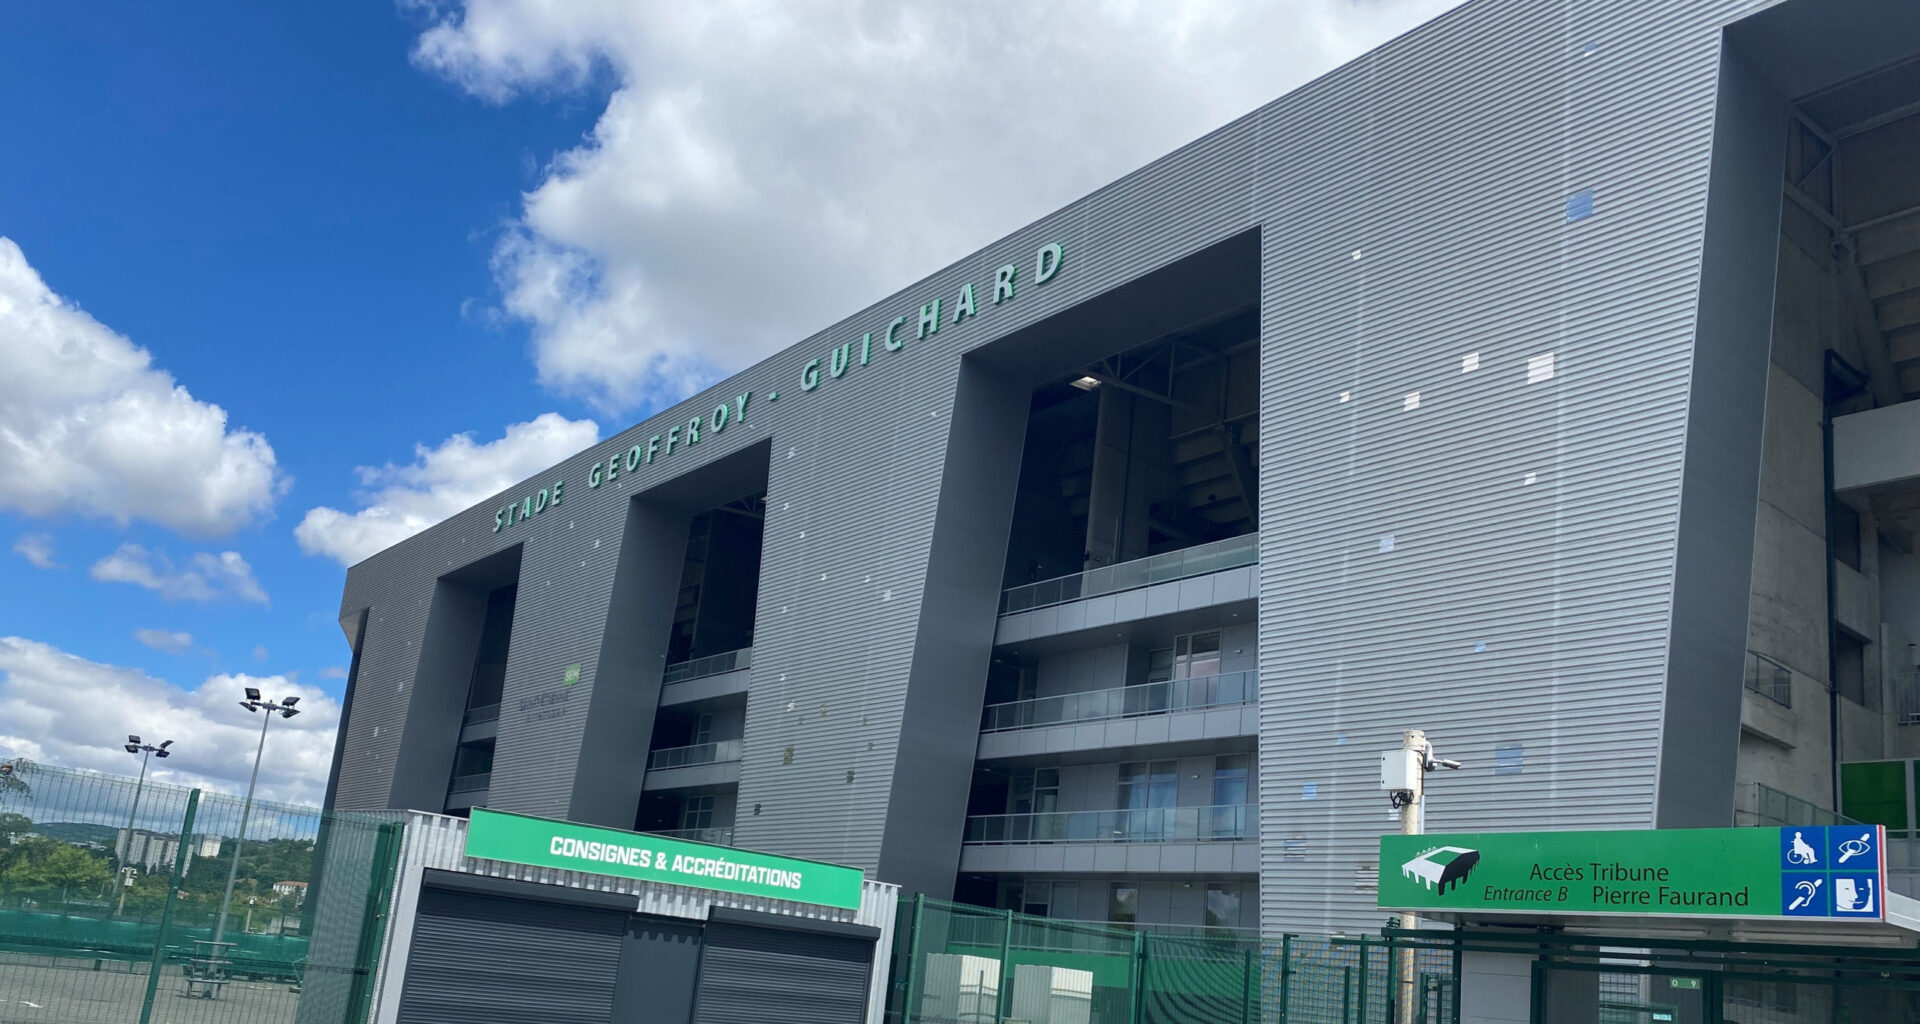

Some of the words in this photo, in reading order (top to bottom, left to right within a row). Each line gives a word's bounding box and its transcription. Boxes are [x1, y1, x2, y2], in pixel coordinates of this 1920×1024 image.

[493, 480, 565, 532] STADE
[588, 391, 752, 489] GEOFFROY
[800, 242, 1063, 392] GUICHARD
[550, 836, 652, 868] CONSIGNES
[654, 852, 667, 871] &
[671, 854, 802, 889] ACCRÉDITATIONS
[1529, 862, 1584, 881] Accès
[1589, 862, 1669, 882] Tribune
[1483, 885, 1553, 902] Entrance
[1557, 886, 1569, 902] B
[1592, 885, 1651, 905] Pierre
[1658, 886, 1749, 907] Faurand
